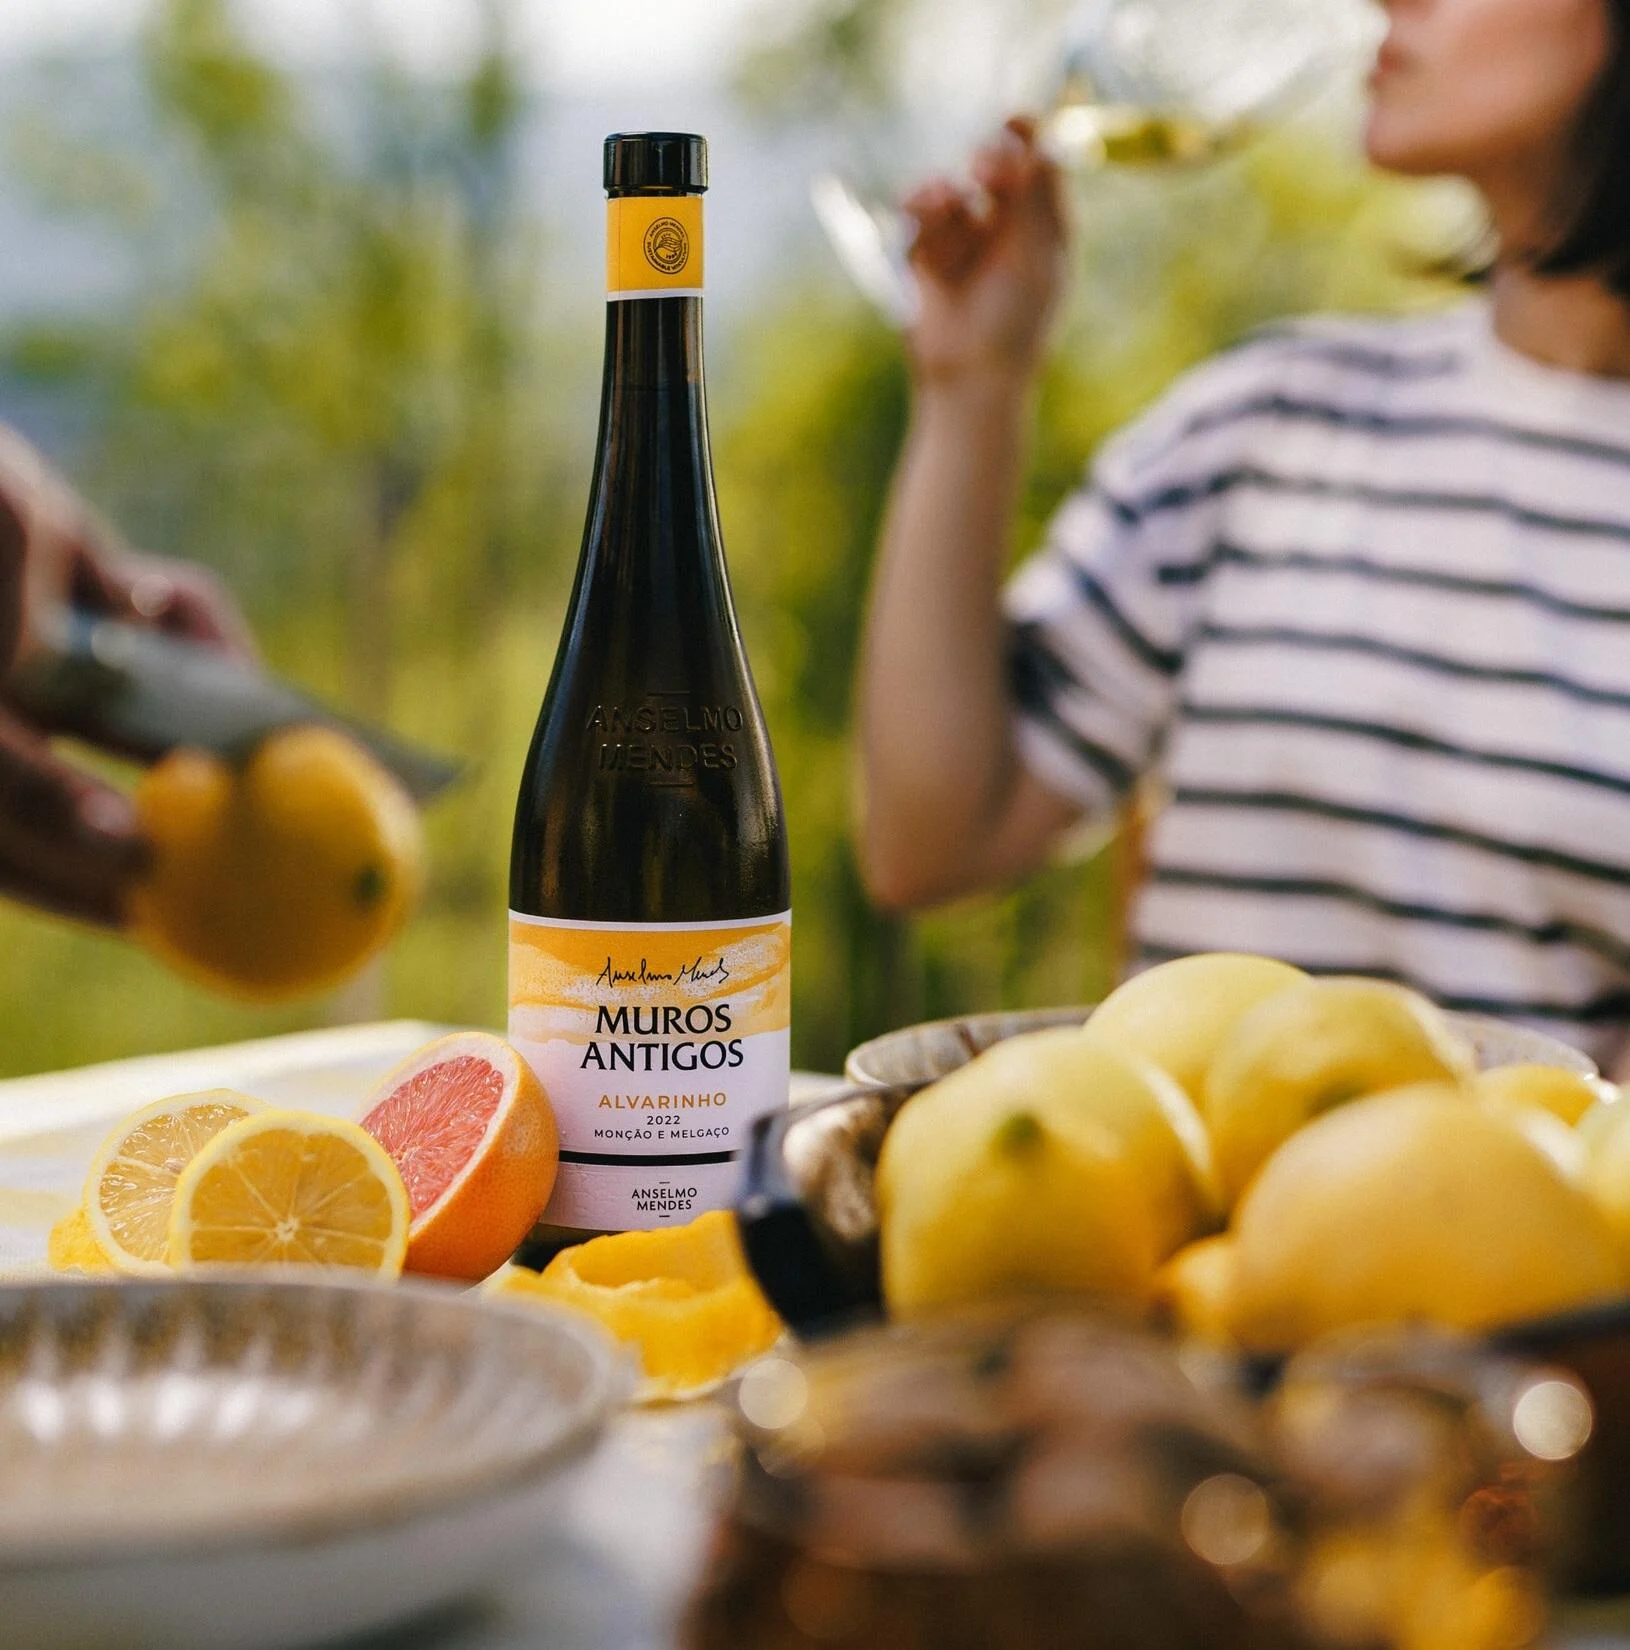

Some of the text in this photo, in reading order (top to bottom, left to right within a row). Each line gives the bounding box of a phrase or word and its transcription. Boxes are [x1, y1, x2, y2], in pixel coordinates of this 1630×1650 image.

[586, 704, 744, 732] ANSELMO
[598, 743, 738, 770] MENDES
[595, 1004, 732, 1035] MUROS
[580, 1038, 744, 1071] ANTIGOS
[598, 1092, 727, 1110] ALVARINHO
[646, 1115, 681, 1126] 2022
[594, 1127, 730, 1141] MONÇÃO E MELGAÇO
[631, 1187, 697, 1199] ANSELMO
[637, 1200, 692, 1210] MENDES
